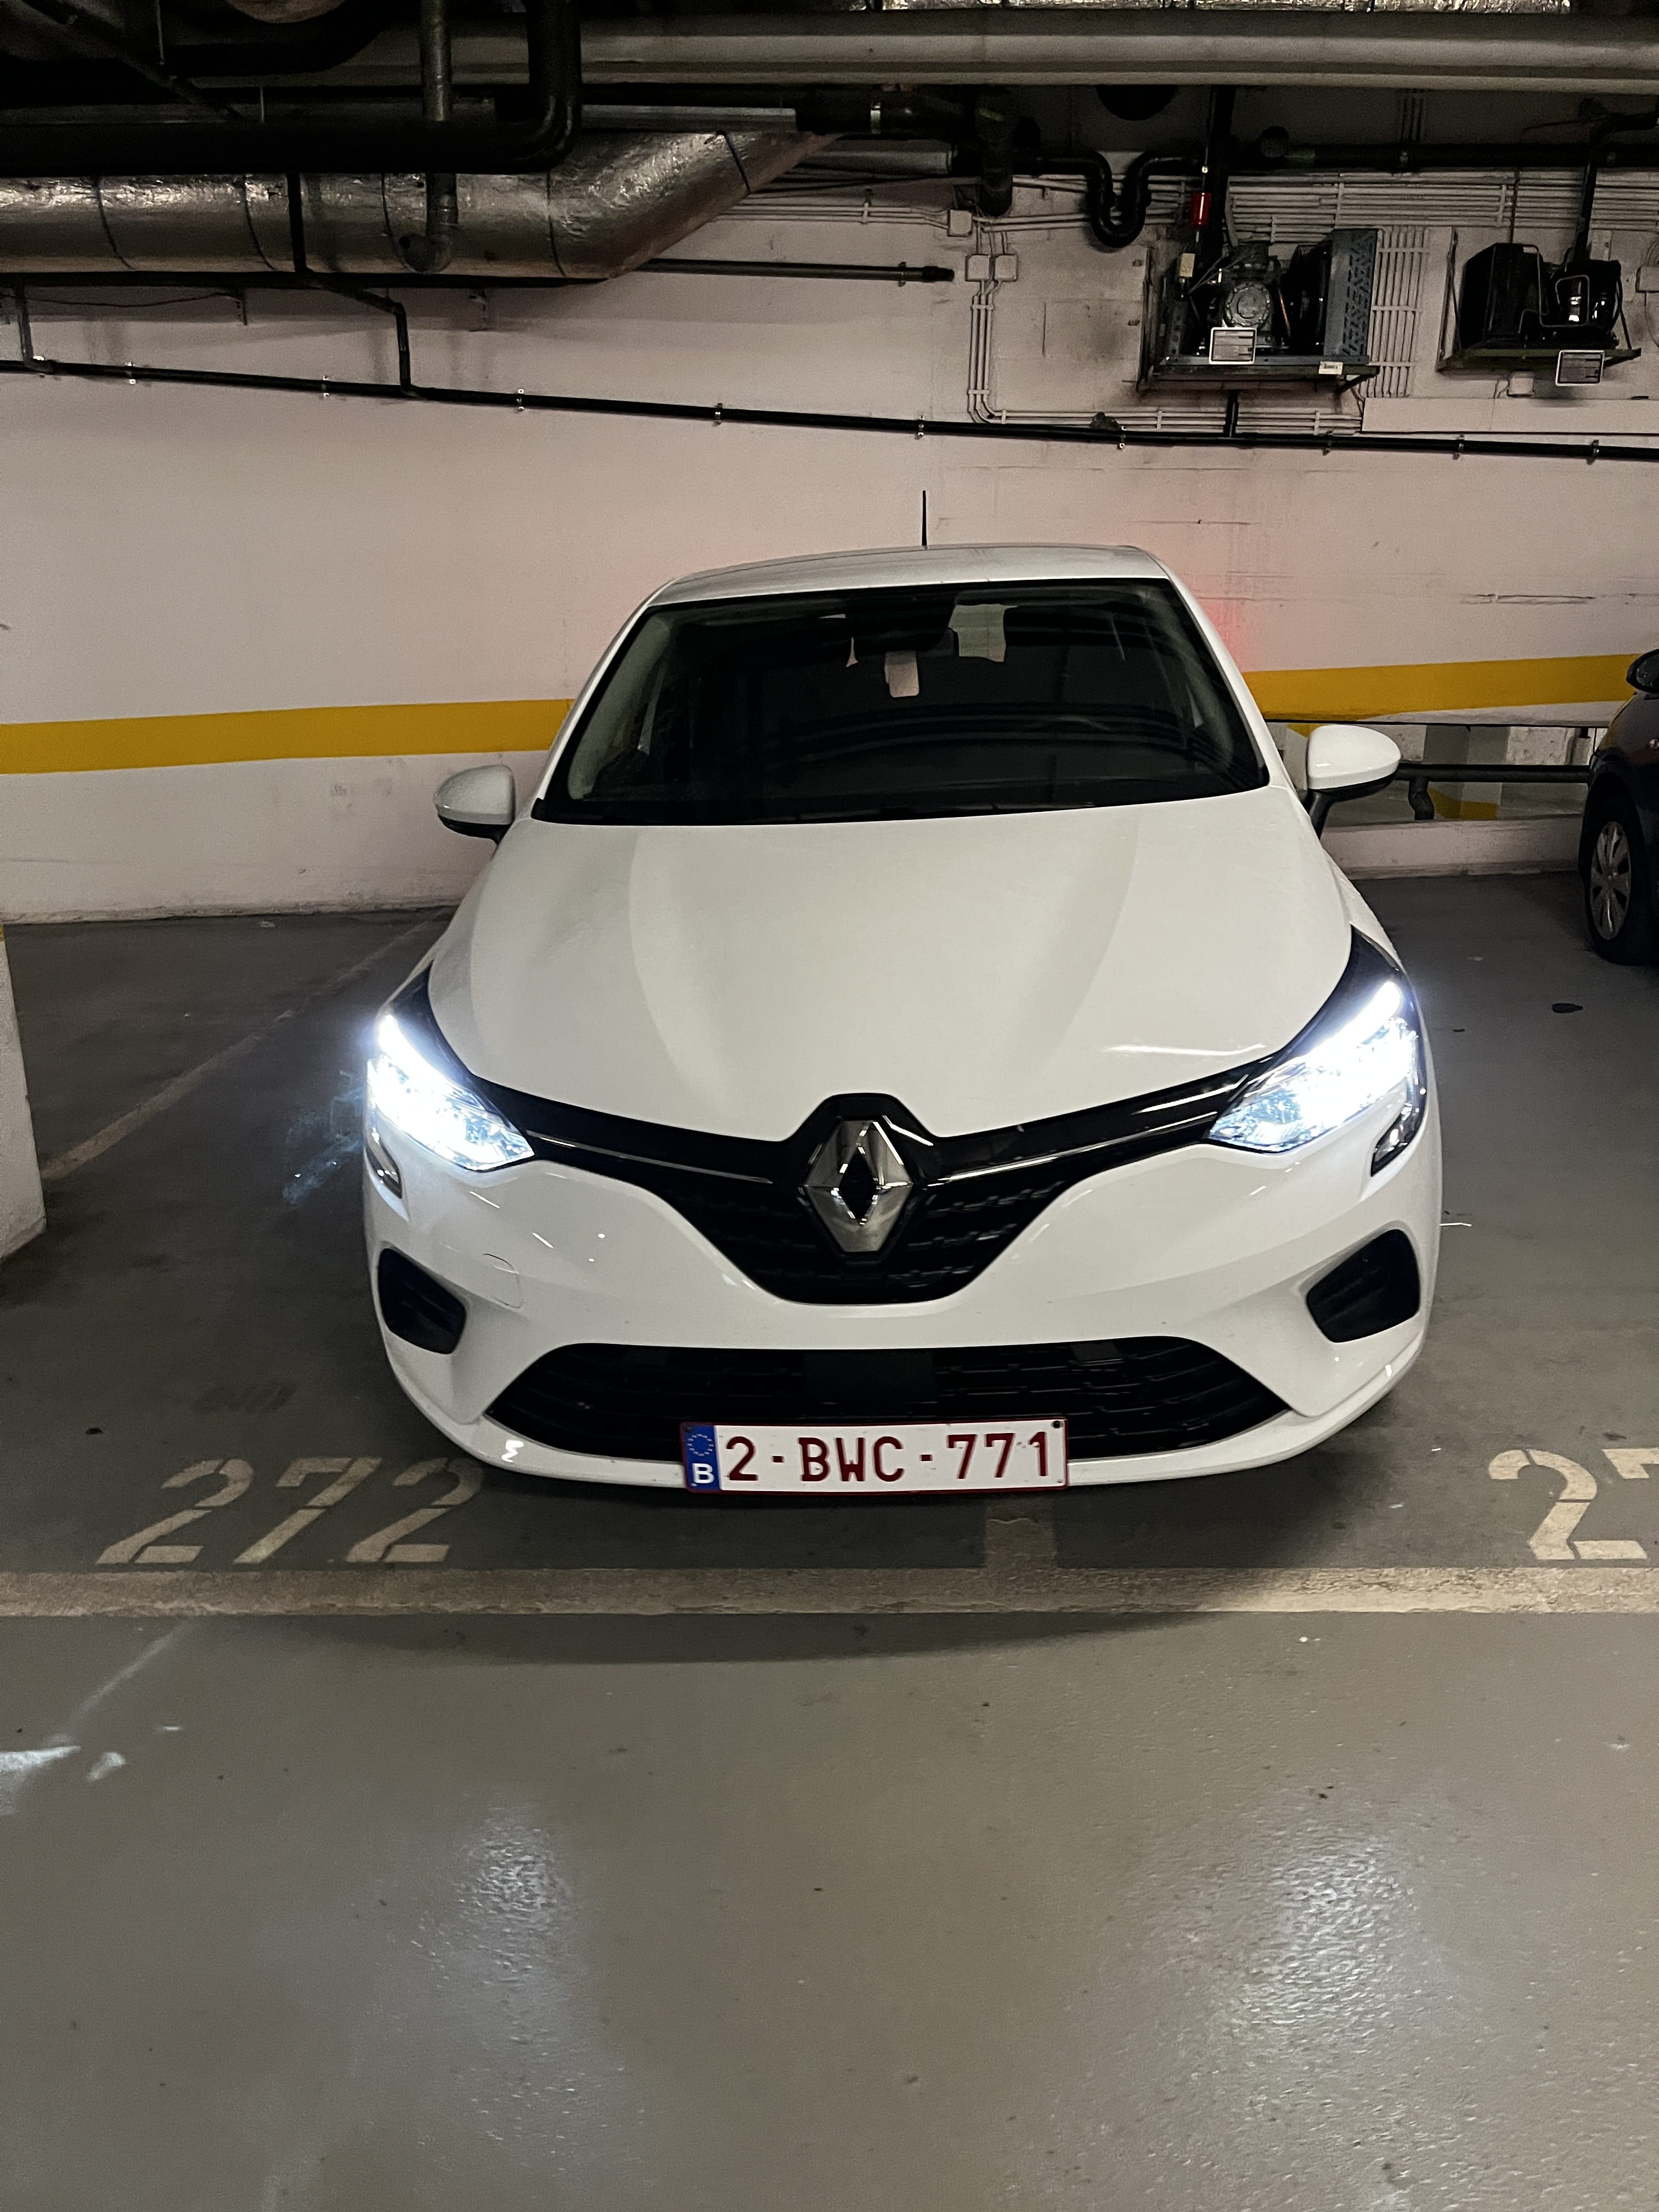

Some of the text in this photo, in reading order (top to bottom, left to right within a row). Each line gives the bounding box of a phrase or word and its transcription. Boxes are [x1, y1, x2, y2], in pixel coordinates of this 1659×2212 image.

[692, 1463, 715, 1484] B
[725, 1431, 1049, 1482] 2-BWC-771
[96, 1457, 484, 1564] 272
